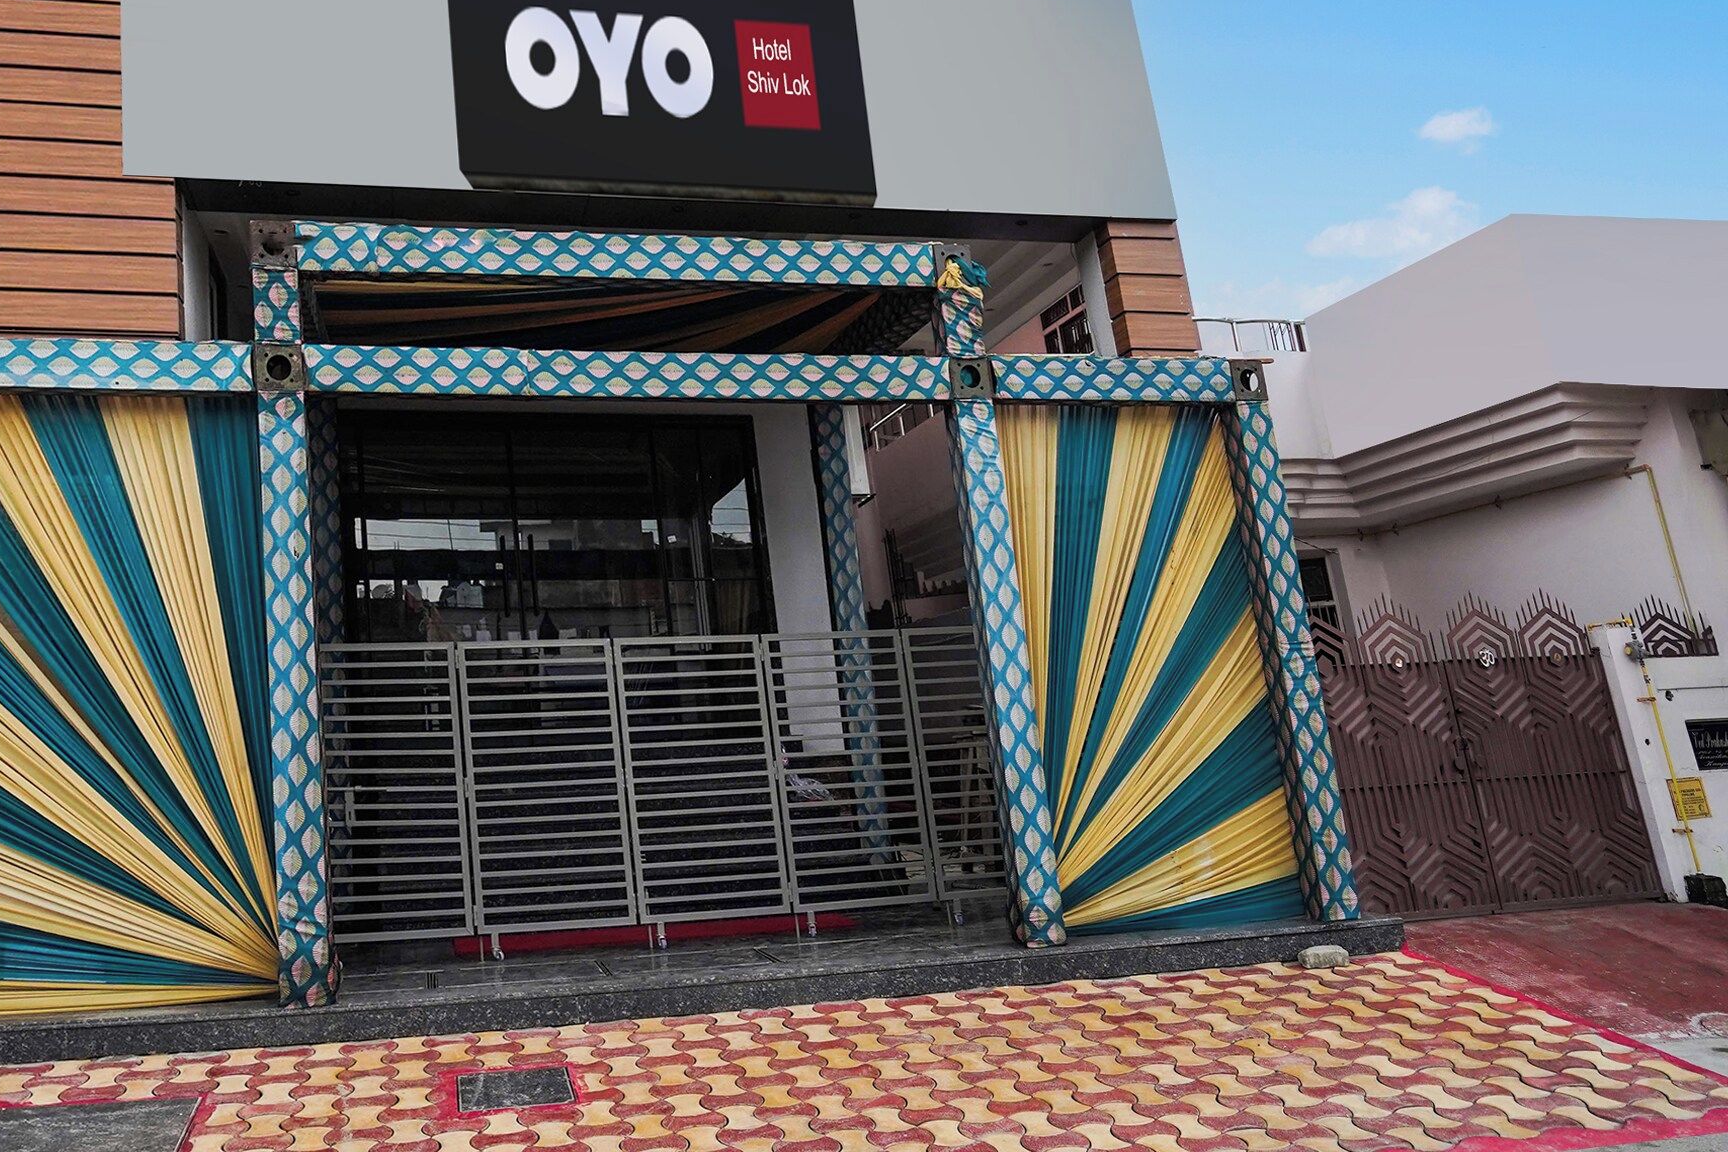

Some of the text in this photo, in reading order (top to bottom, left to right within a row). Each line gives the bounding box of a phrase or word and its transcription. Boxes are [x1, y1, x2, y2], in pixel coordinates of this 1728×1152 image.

[504, 6, 714, 118] OYO
[752, 37, 792, 61] Hotel
[747, 70, 812, 96] Shiv Lok
